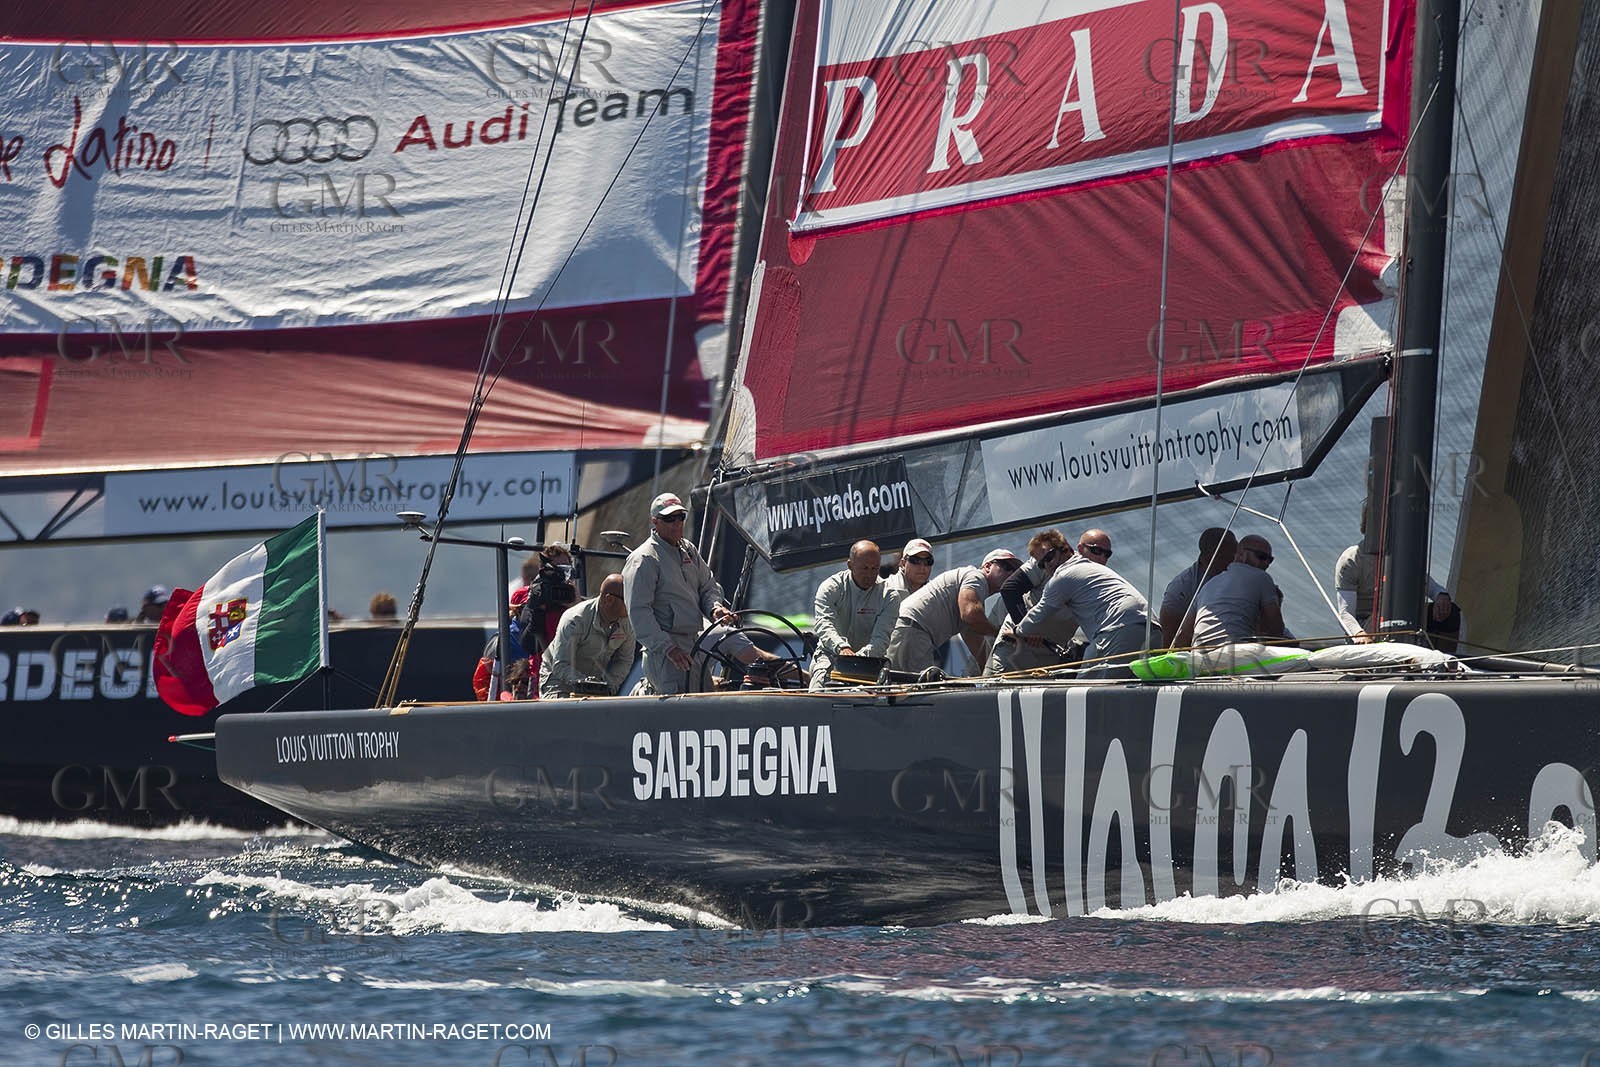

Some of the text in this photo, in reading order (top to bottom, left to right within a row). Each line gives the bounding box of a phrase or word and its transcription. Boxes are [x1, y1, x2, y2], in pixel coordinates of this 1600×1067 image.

[810, 0, 1368, 194] PRADA
[43, 96, 176, 188] Latino
[394, 103, 529, 153] Audi
[548, 88, 694, 134] Team
[0, 254, 198, 292] DEGNA
[1008, 411, 1293, 490] www.louisvuittontrophy.com
[767, 481, 911, 533] www.prada.com
[276, 731, 400, 764] LOUIS VUITTON TROPHY
[632, 725, 837, 801] SARDEGNA
